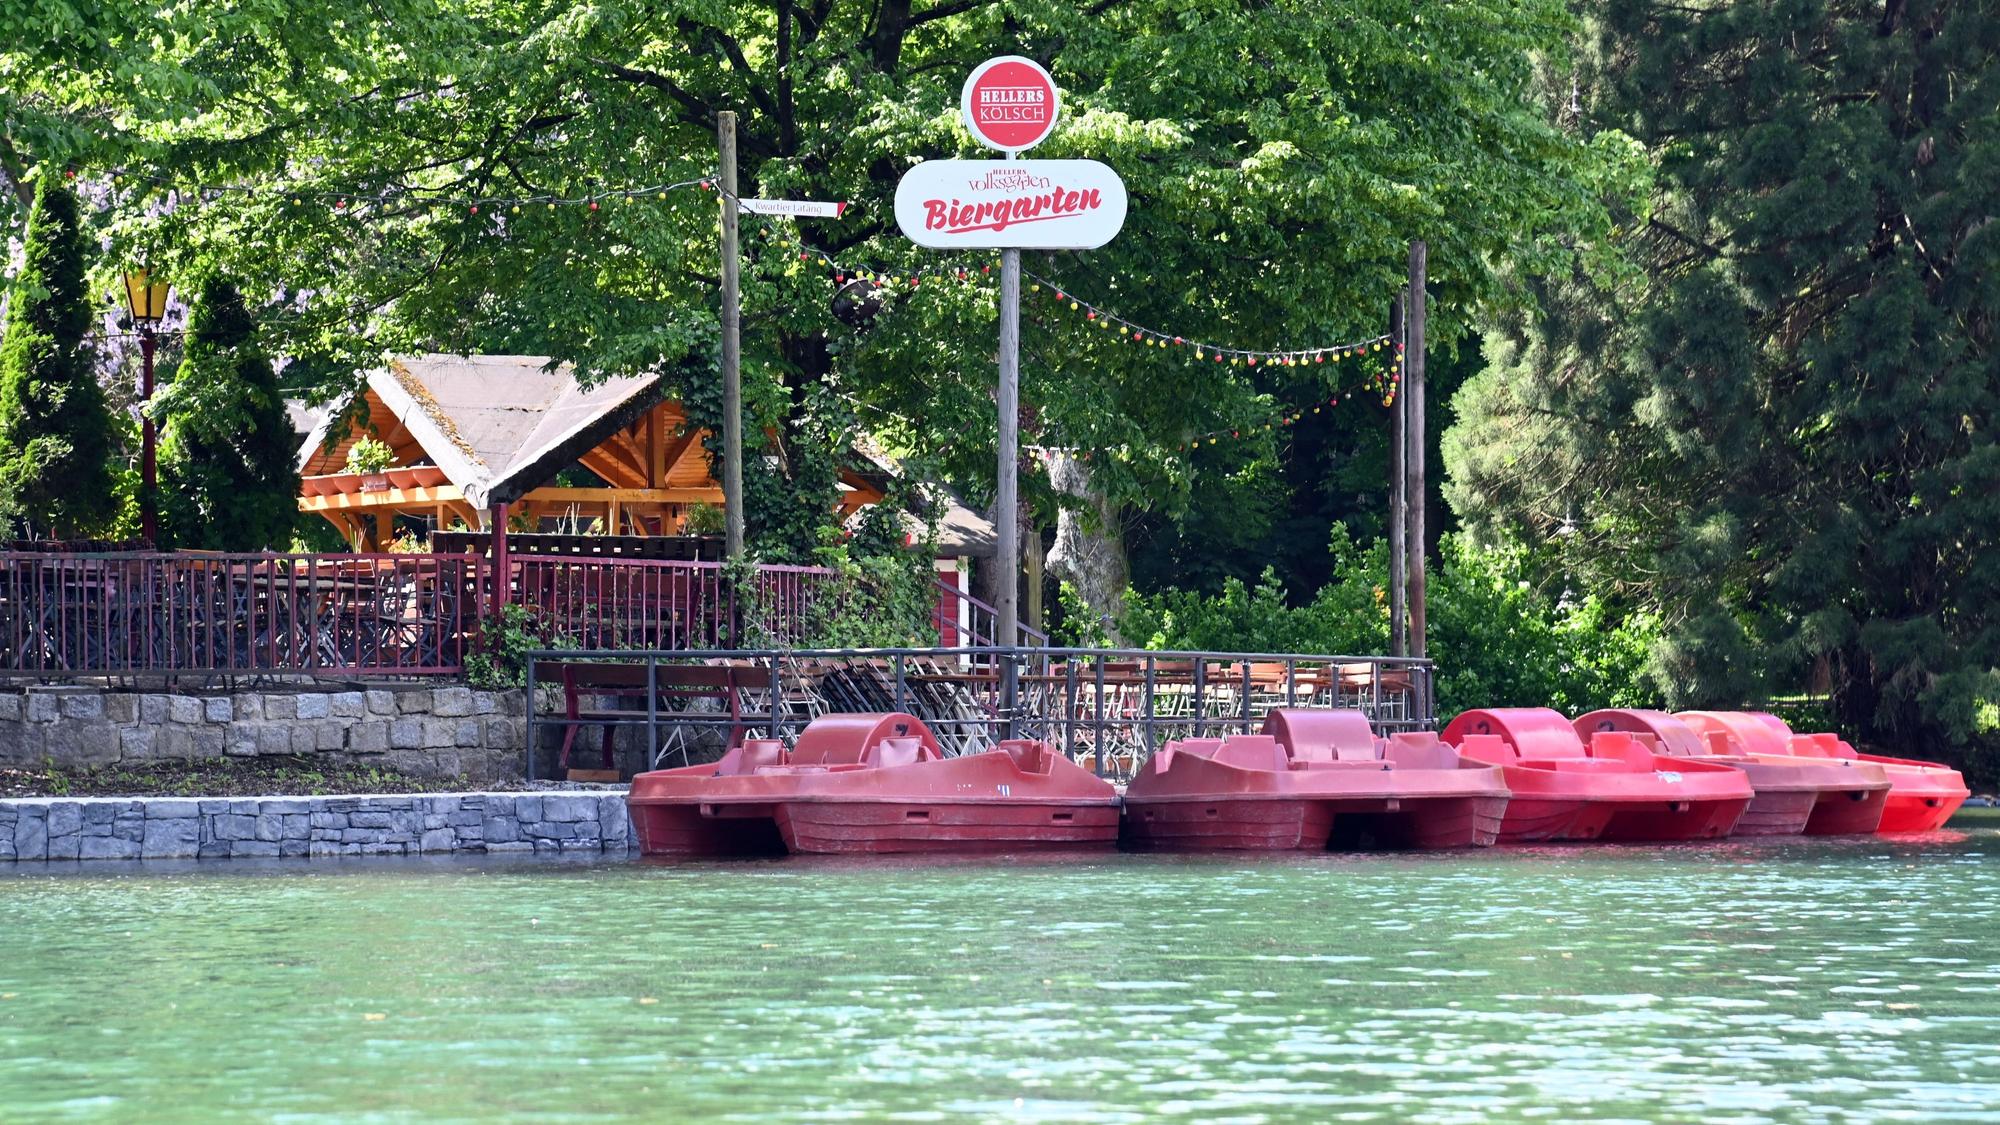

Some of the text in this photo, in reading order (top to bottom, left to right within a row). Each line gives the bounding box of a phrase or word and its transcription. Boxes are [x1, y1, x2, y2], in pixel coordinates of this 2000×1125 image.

[980, 90, 1044, 103] HELLERS
[980, 106, 1044, 120] KÖLSCH
[755, 201, 791, 211] Kwartier
[923, 186, 1101, 232] Biergarten
